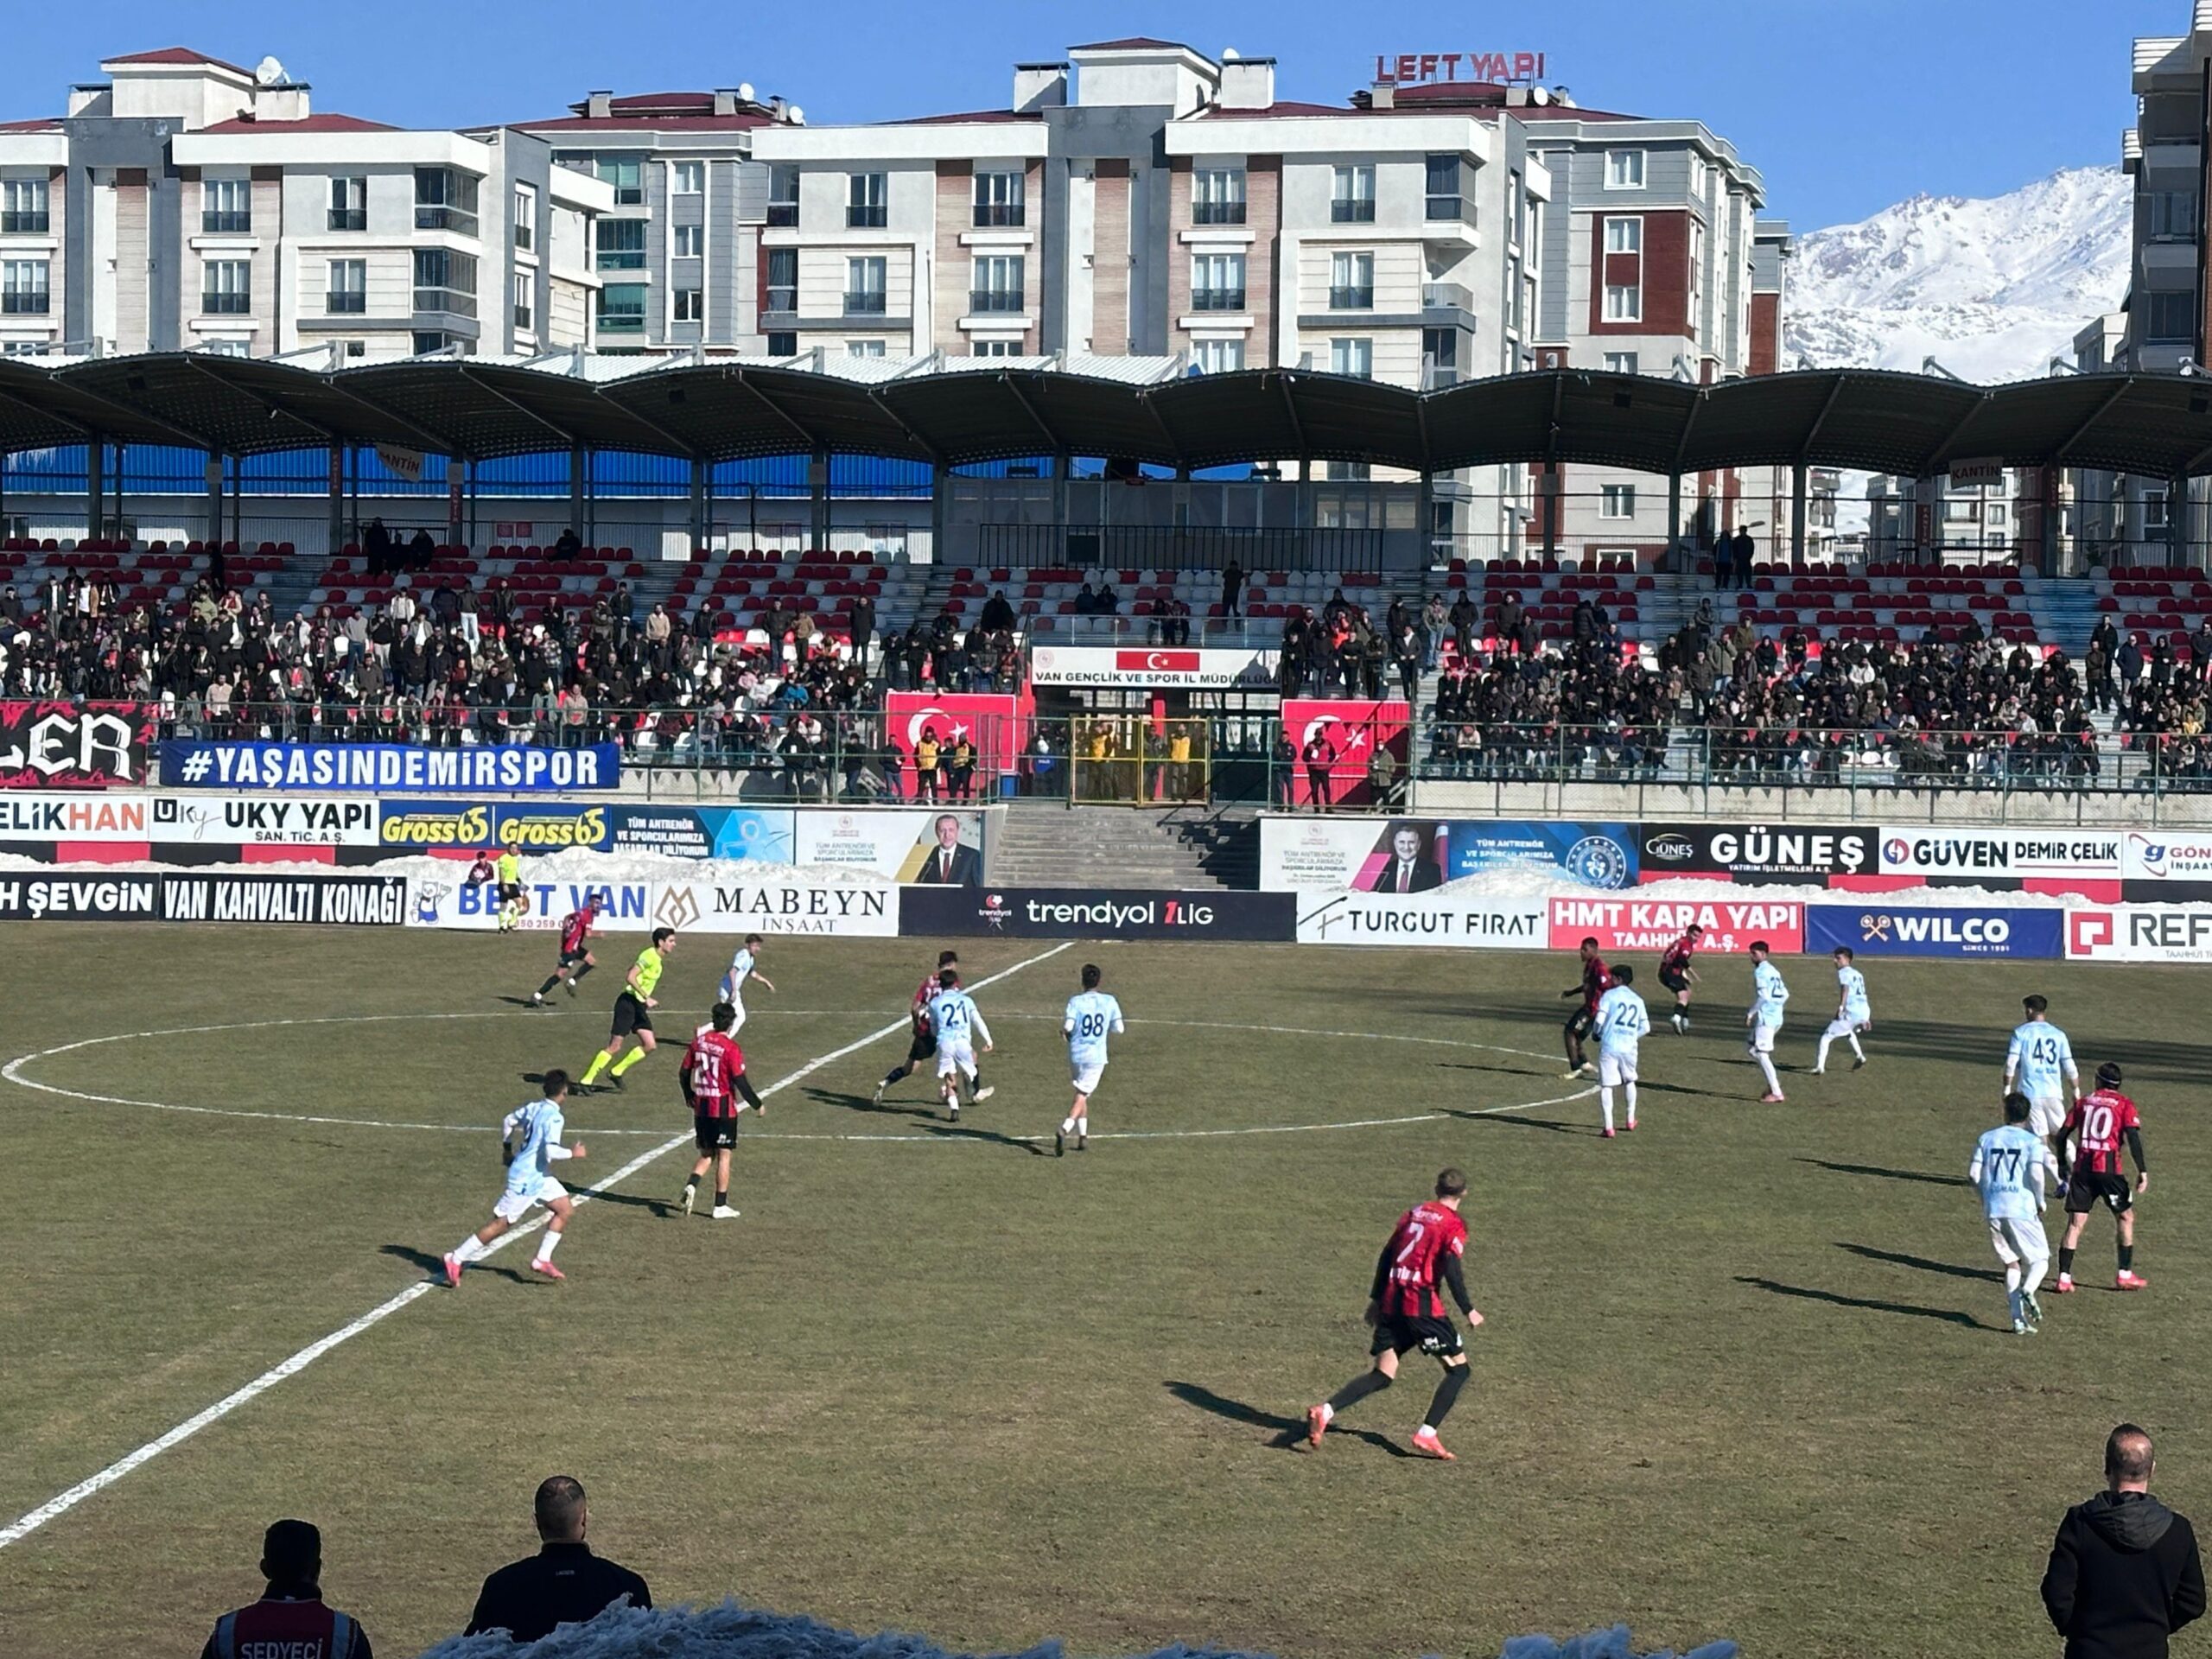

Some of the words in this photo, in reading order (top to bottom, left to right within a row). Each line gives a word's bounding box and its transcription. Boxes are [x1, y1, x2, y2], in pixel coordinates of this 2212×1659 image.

[1377, 55, 1462, 82] LEFT
[1470, 53, 1544, 80] YAPI
[1036, 672, 1061, 682] VAN
[1065, 671, 1122, 685] GENÇLİK
[1126, 673, 1141, 683] VE
[1147, 673, 1180, 683] SPOR
[1185, 671, 1196, 683] İL
[181, 747, 598, 787] #YAŞASINDEMİRSPOR
[226, 802, 290, 829] UKY
[300, 804, 372, 830] YAPI
[627, 816, 646, 829] TÜM
[255, 831, 287, 842] SAN.
[320, 832, 346, 845] A.Ş.
[617, 830, 628, 842] VE
[1477, 838, 1495, 848] TÜM
[1465, 849, 1478, 858] VE
[1710, 826, 1865, 874] GÜNEŞ
[1913, 838, 2008, 868] GÜVEN
[2014, 842, 2067, 860] DEMİR
[2070, 842, 2118, 862] ÇELİK
[164, 880, 208, 920] VAN
[213, 880, 315, 922] KAHVALTI
[321, 877, 404, 924] KONAĞI
[459, 883, 556, 917] BET
[569, 884, 645, 918] VAN
[713, 887, 887, 916] MABEYN
[1027, 899, 1154, 928] trendyol
[762, 914, 837, 933] İNŞAAT
[1349, 910, 1454, 933] TURGUT
[1466, 913, 1538, 936] FIRAT
[1554, 901, 1624, 926] HMT
[1631, 903, 1719, 929] KARA
[1726, 906, 1797, 930] YAPI
[1612, 930, 1696, 948] TAAHH
[1703, 933, 1739, 952] A.Ş.
[1893, 917, 2010, 944] WILCO
[942, 1001, 968, 1028] 21
[1081, 1013, 1104, 1037] 98
[1615, 1001, 1638, 1028] 22
[2032, 1038, 2056, 1065] 43
[2083, 1104, 2113, 1141] 10
[1990, 1148, 2022, 1182] 77
[241, 1638, 323, 1659] SEDYECİ
